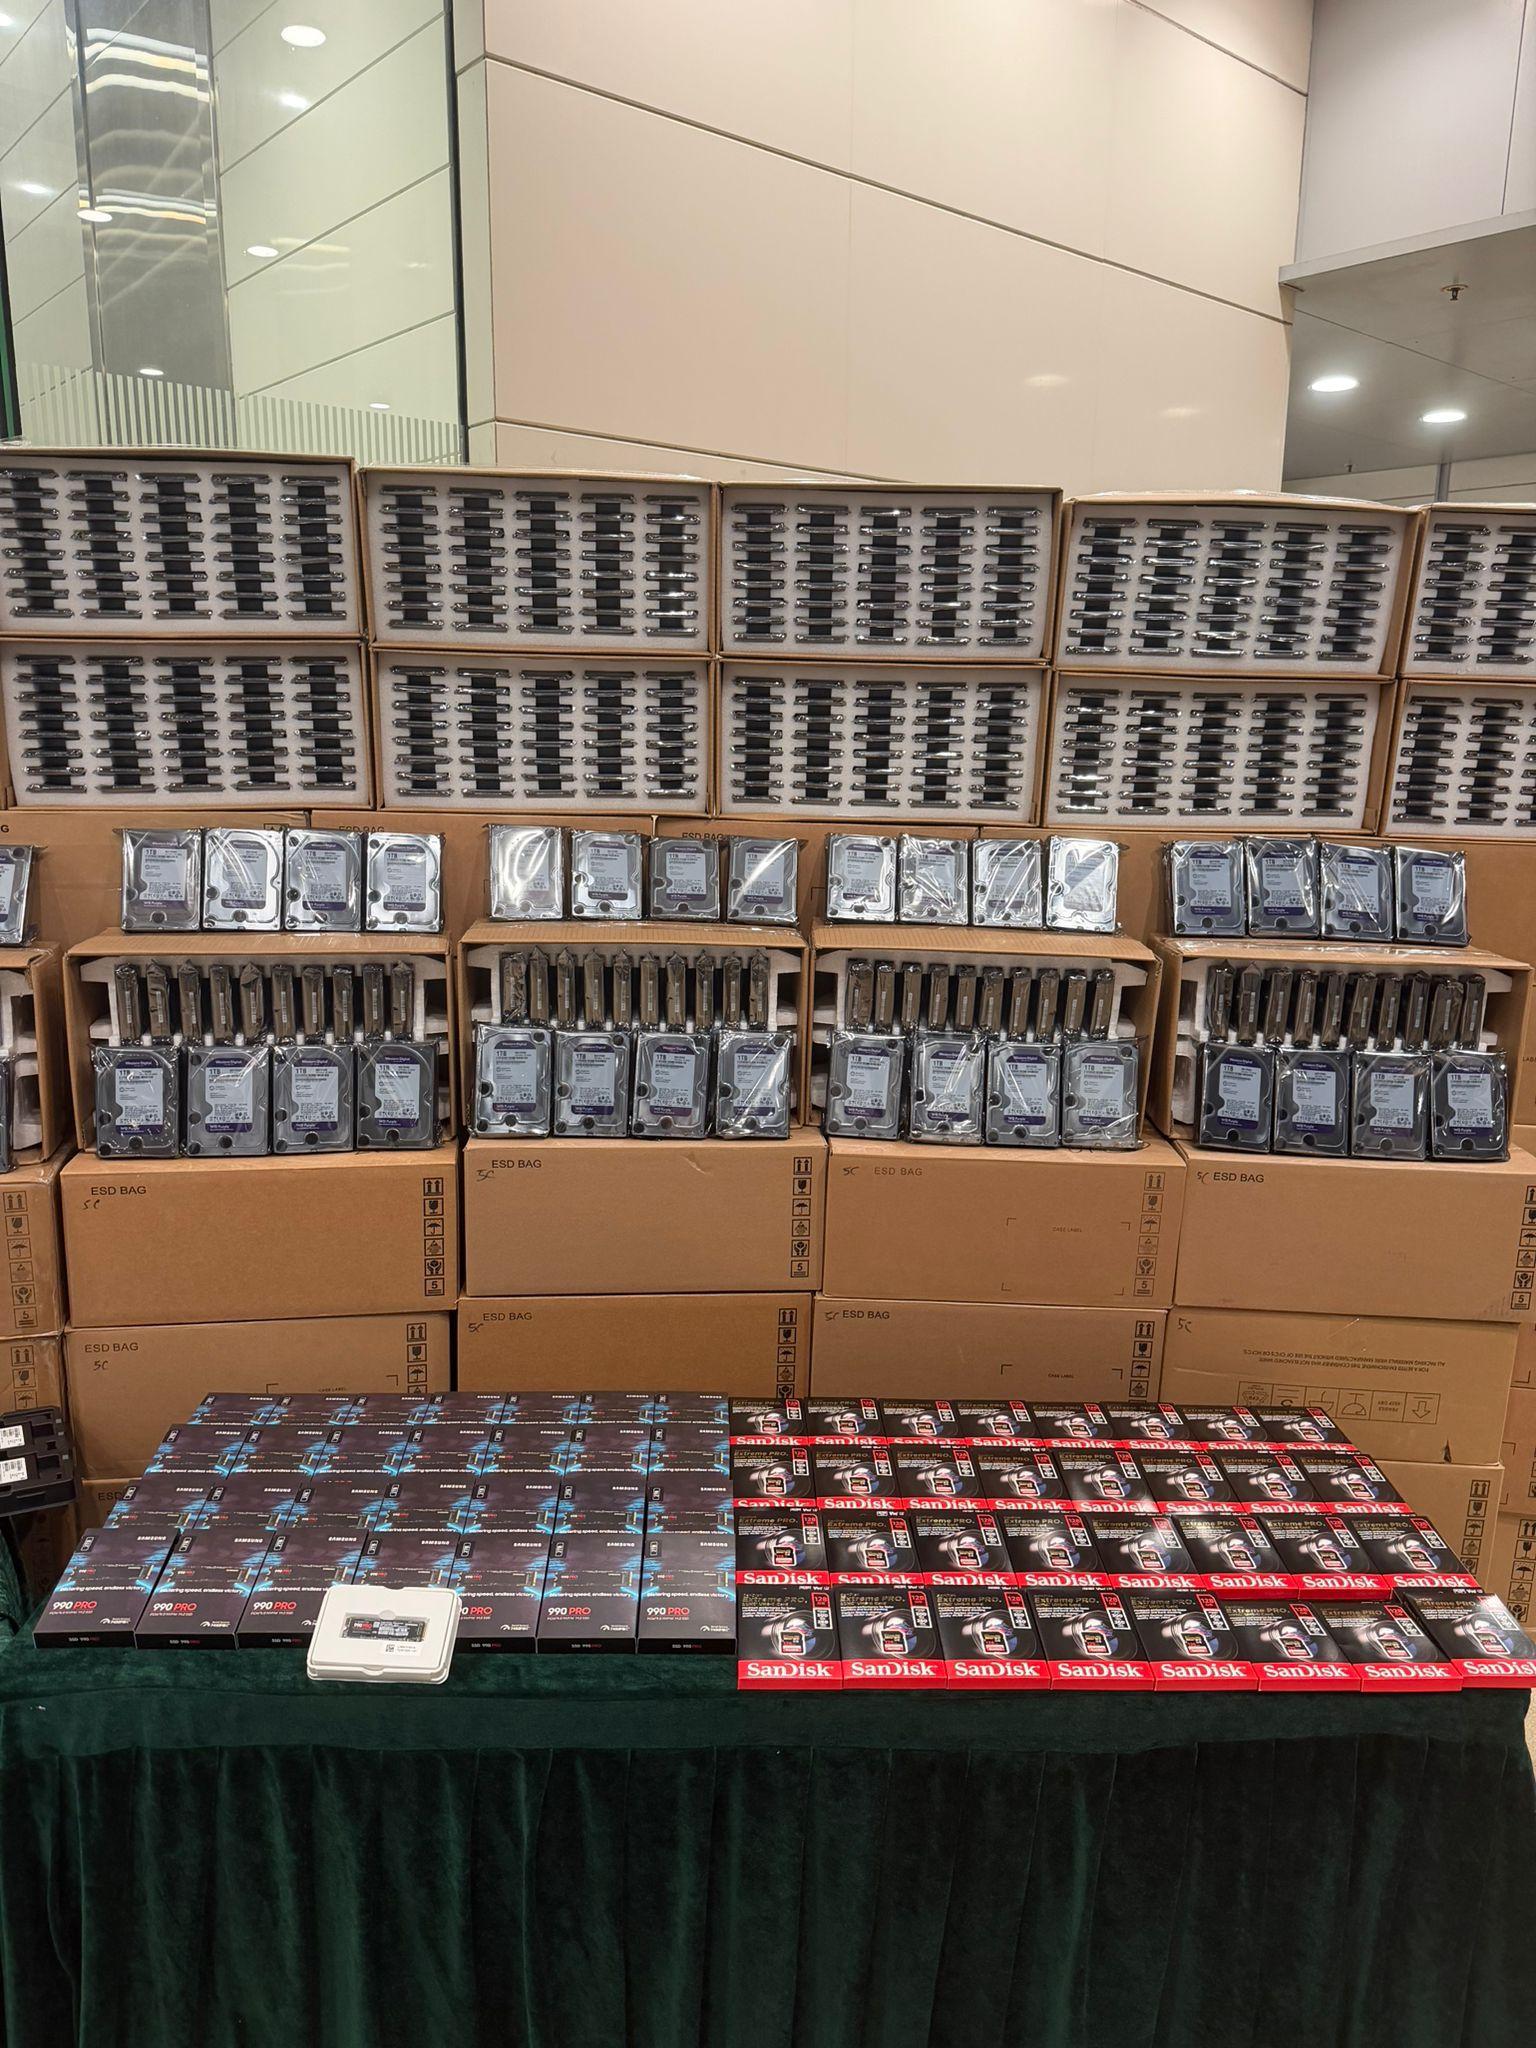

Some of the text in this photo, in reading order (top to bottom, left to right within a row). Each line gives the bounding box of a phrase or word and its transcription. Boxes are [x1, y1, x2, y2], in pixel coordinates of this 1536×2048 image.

[492, 1160, 541, 1168] ESD BAG
[874, 1167, 922, 1176] ESD BAG
[1214, 1172, 1264, 1183] ESD BAG
[91, 1186, 146, 1195] ESD BAG
[509, 1312, 532, 1320] BAG
[843, 1310, 889, 1319] ESD BAG
[85, 1342, 139, 1352] ESD BAG
[737, 1437, 801, 1445] SanDisk
[973, 1438, 1037, 1446] SanDisk
[1130, 1441, 1193, 1449] SanDisk
[824, 1499, 893, 1509] SanDisk
[910, 1500, 977, 1509] SanDisk
[995, 1500, 1063, 1510] SanDisk
[1251, 1503, 1320, 1513] SanDisk
[1334, 1503, 1401, 1513] SanDisk
[744, 1572, 818, 1584] SanDisk
[932, 1574, 1006, 1585] SanDisk
[1025, 1575, 1099, 1586] SanDisk
[1118, 1576, 1192, 1587] SanDisk
[1210, 1576, 1285, 1587] SanDisk
[1302, 1576, 1376, 1587] SanDisk
[1394, 1576, 1468, 1587] SanDisk
[52, 1601, 97, 1610] 990 PRO
[153, 1603, 197, 1611] 990 PRO
[253, 1601, 297, 1610] 990 PRO
[470, 1607, 492, 1615] PRO
[569, 1607, 591, 1615] PRO
[647, 1607, 689, 1615] 990 PRO
[747, 1662, 831, 1677] SanDisk
[852, 1662, 935, 1676] SanDisk
[955, 1662, 1039, 1676] SanDisk
[1060, 1663, 1140, 1677] SanDisk
[1161, 1663, 1246, 1677] SanDisk
[1264, 1664, 1348, 1678] SanDisk
[1365, 1665, 1449, 1678] SanDisk
